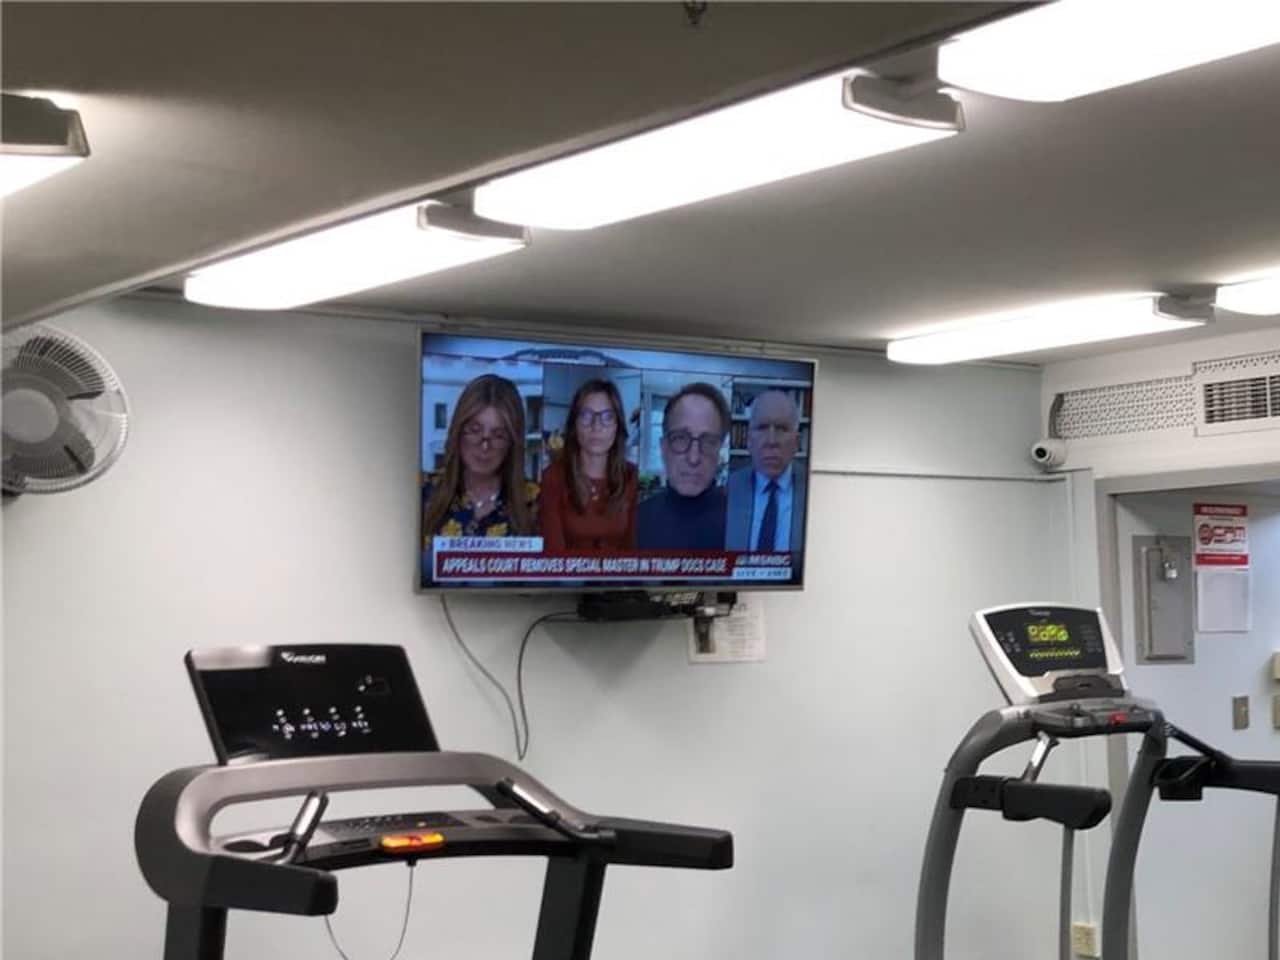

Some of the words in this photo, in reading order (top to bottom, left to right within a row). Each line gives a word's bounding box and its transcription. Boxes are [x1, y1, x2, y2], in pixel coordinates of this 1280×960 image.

[442, 558, 486, 573] APPEALS
[488, 558, 520, 573] COURT
[520, 558, 564, 573] REMOVES
[565, 558, 600, 573] SPECIAL
[602, 558, 638, 573] MASTER
[640, 558, 650, 573] IN
[651, 558, 681, 573] TRUMP
[681, 558, 705, 573] DOCS
[705, 558, 728, 573] CASE
